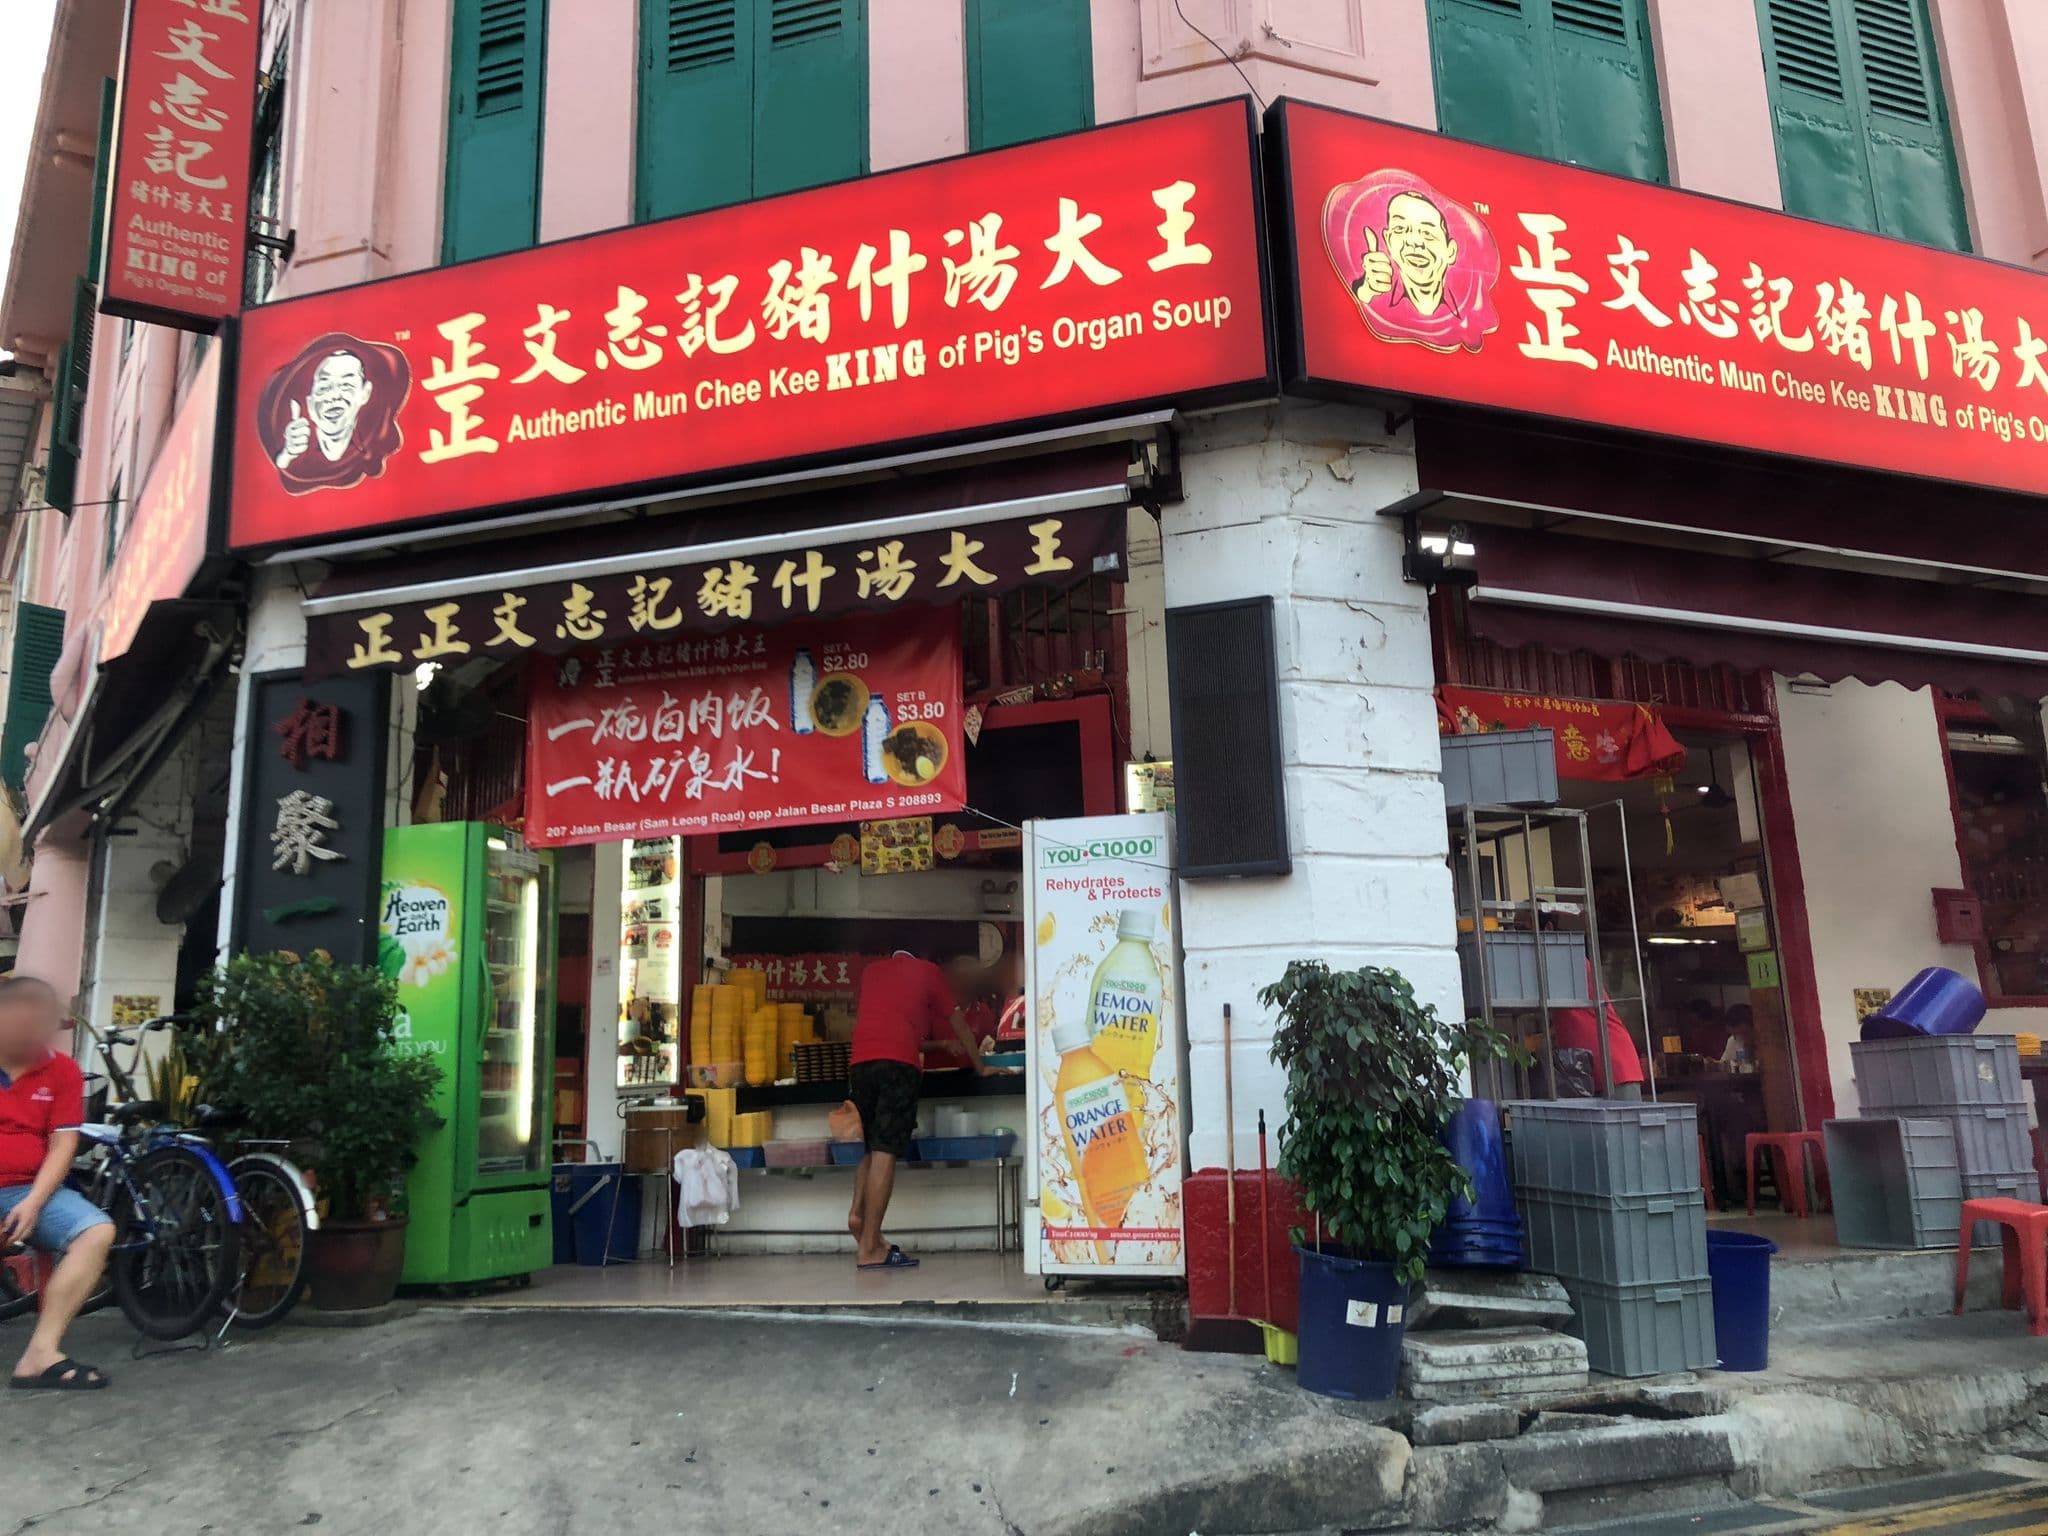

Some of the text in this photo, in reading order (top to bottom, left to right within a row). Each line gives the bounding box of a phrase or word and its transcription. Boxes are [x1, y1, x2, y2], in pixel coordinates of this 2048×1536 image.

[128, 213, 230, 251] Authentic
[126, 247, 228, 285] KING of
[202, 249, 230, 265] Kee
[507, 295, 1233, 443] Authentic Mun Chee Kee KING of Pig's Organ Soup
[1606, 338, 1715, 385] Authentic
[1719, 359, 1767, 394] Mun
[1771, 369, 1826, 404] Chee
[1829, 379, 1871, 412] Kee
[1872, 383, 1948, 428] KING
[1955, 404, 1975, 431] of
[1978, 405, 2026, 442] Pig's
[823, 643, 841, 654] SET
[823, 652, 869, 673] $2.80
[896, 690, 926, 703] SET B
[547, 686, 779, 745] 一碗卤肉饭
[897, 701, 945, 721] $3.80
[546, 792, 943, 838] 207 Jalan Besar (Sam Leong Road) opp Jalan Besar Plaza S 208893
[1045, 876, 1125, 893] Rehydrates
[1087, 886, 1162, 901] & Protects
[383, 890, 447, 923] Heaven
[410, 911, 428, 921] and
[395, 917, 441, 936] Earth
[1094, 991, 1154, 1015] LEMON
[1093, 1010, 1149, 1033] WATER
[1065, 1098, 1124, 1130] ORANGE
[1071, 1118, 1128, 1147] WATER
